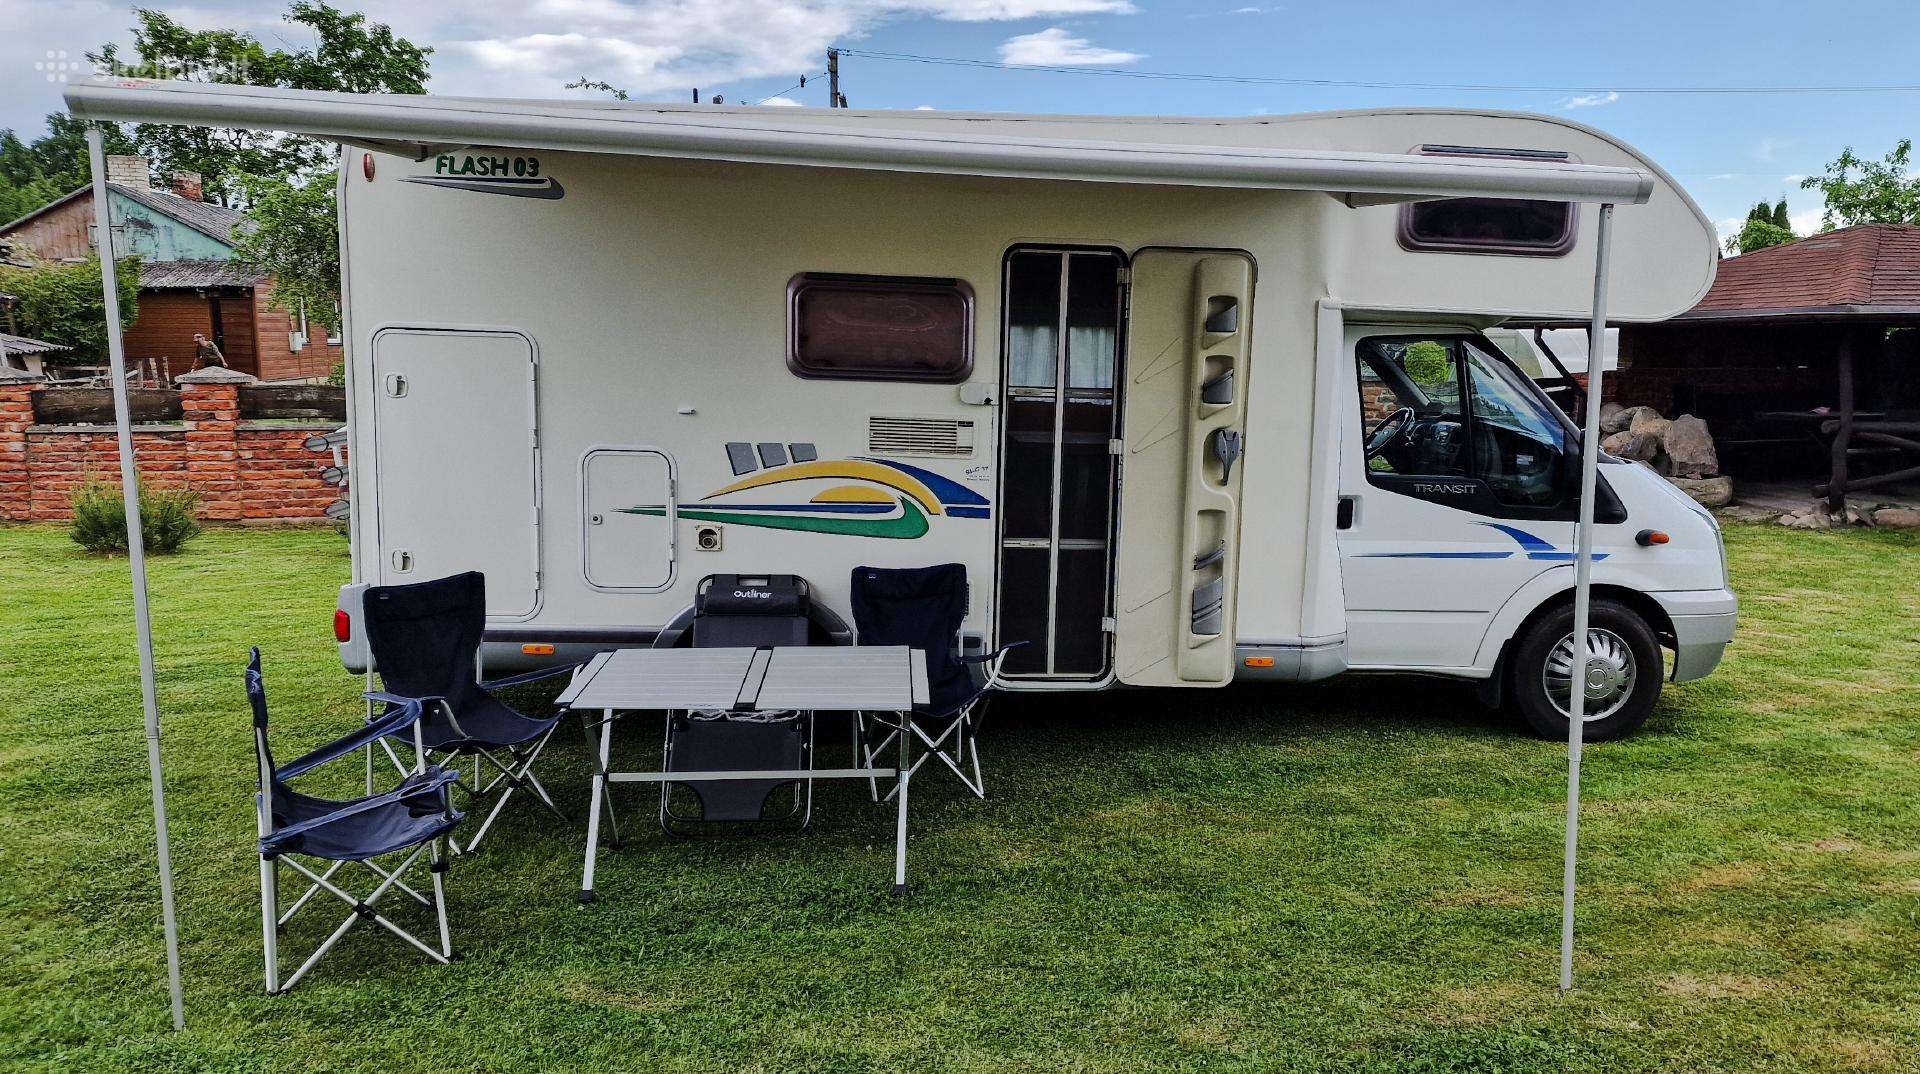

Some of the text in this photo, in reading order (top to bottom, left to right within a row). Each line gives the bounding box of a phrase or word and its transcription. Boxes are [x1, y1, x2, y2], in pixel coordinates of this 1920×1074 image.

[435, 155, 540, 178] FLASH 03
[1413, 483, 1477, 494] TRANSIT
[733, 588, 772, 599] Outliner
